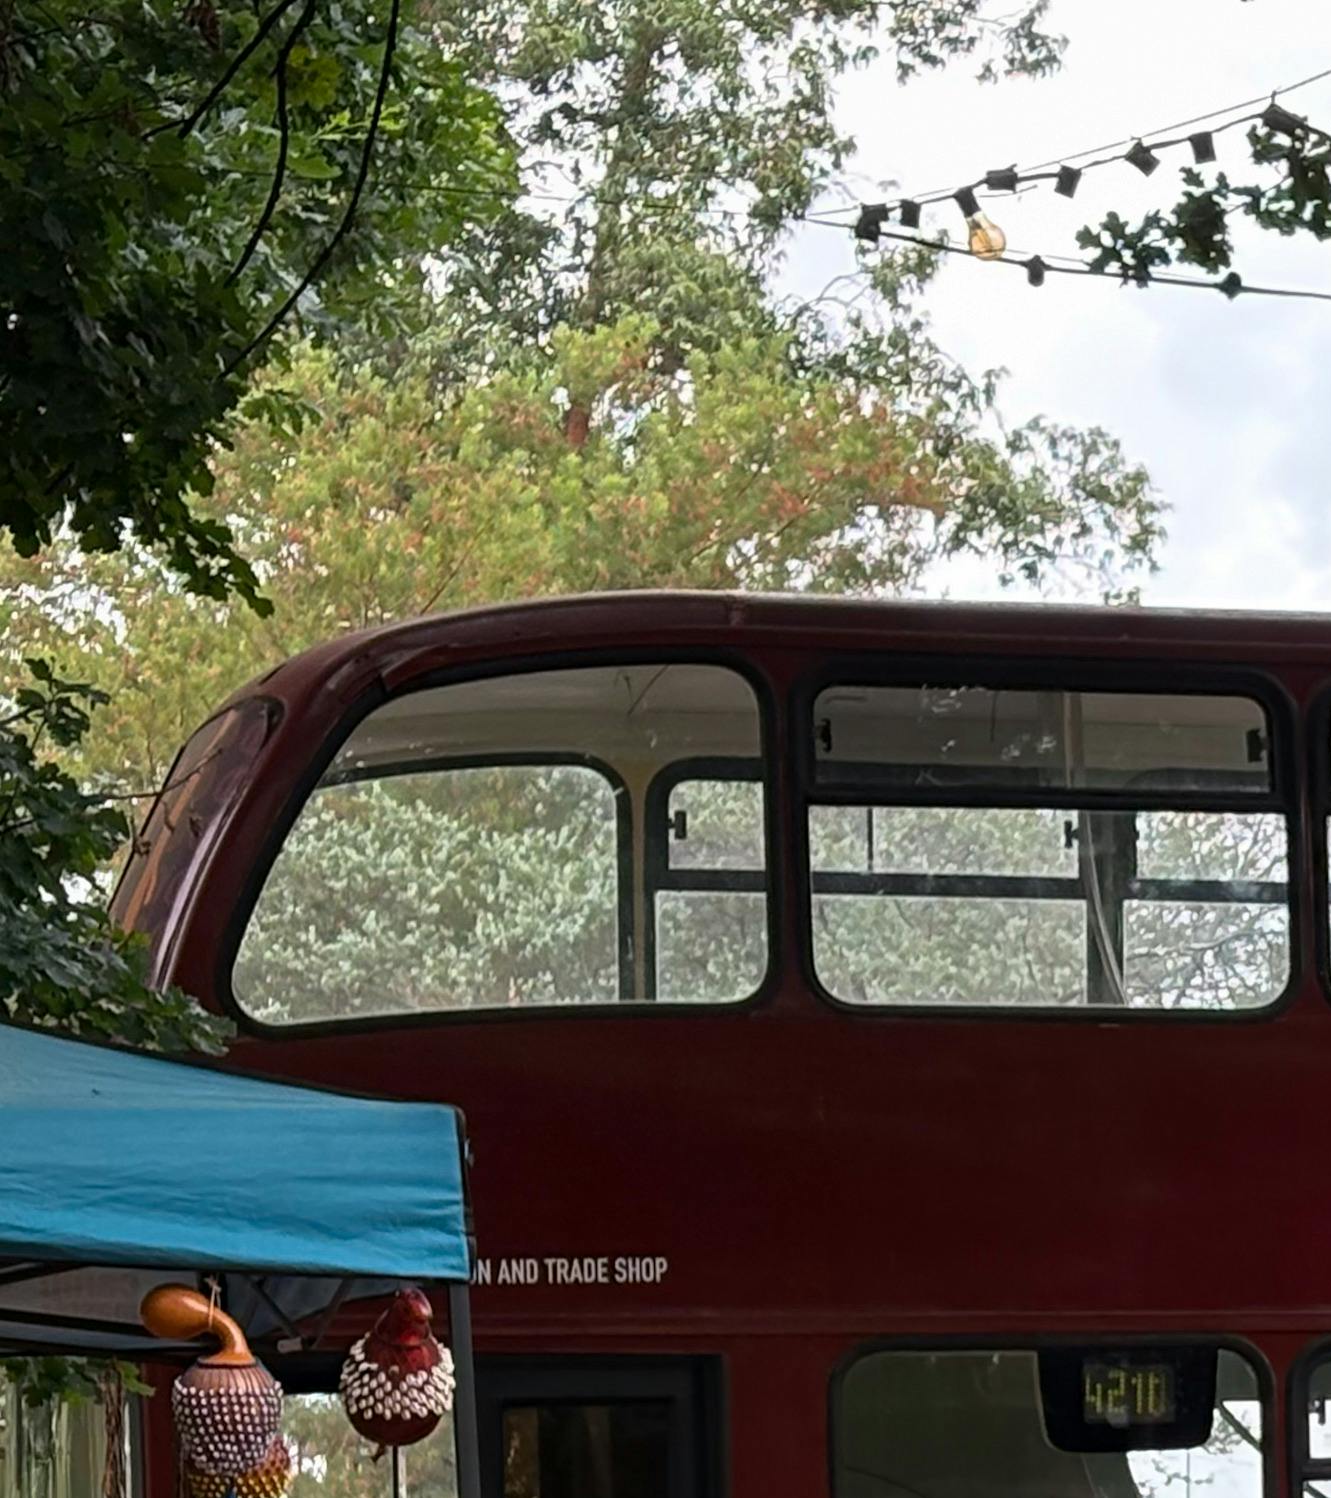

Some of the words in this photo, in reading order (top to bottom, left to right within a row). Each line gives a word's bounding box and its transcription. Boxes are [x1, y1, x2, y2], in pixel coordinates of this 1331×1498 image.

[497, 1257, 539, 1285] AND
[544, 1256, 609, 1284] TRADE
[614, 1256, 668, 1283] SHOP
